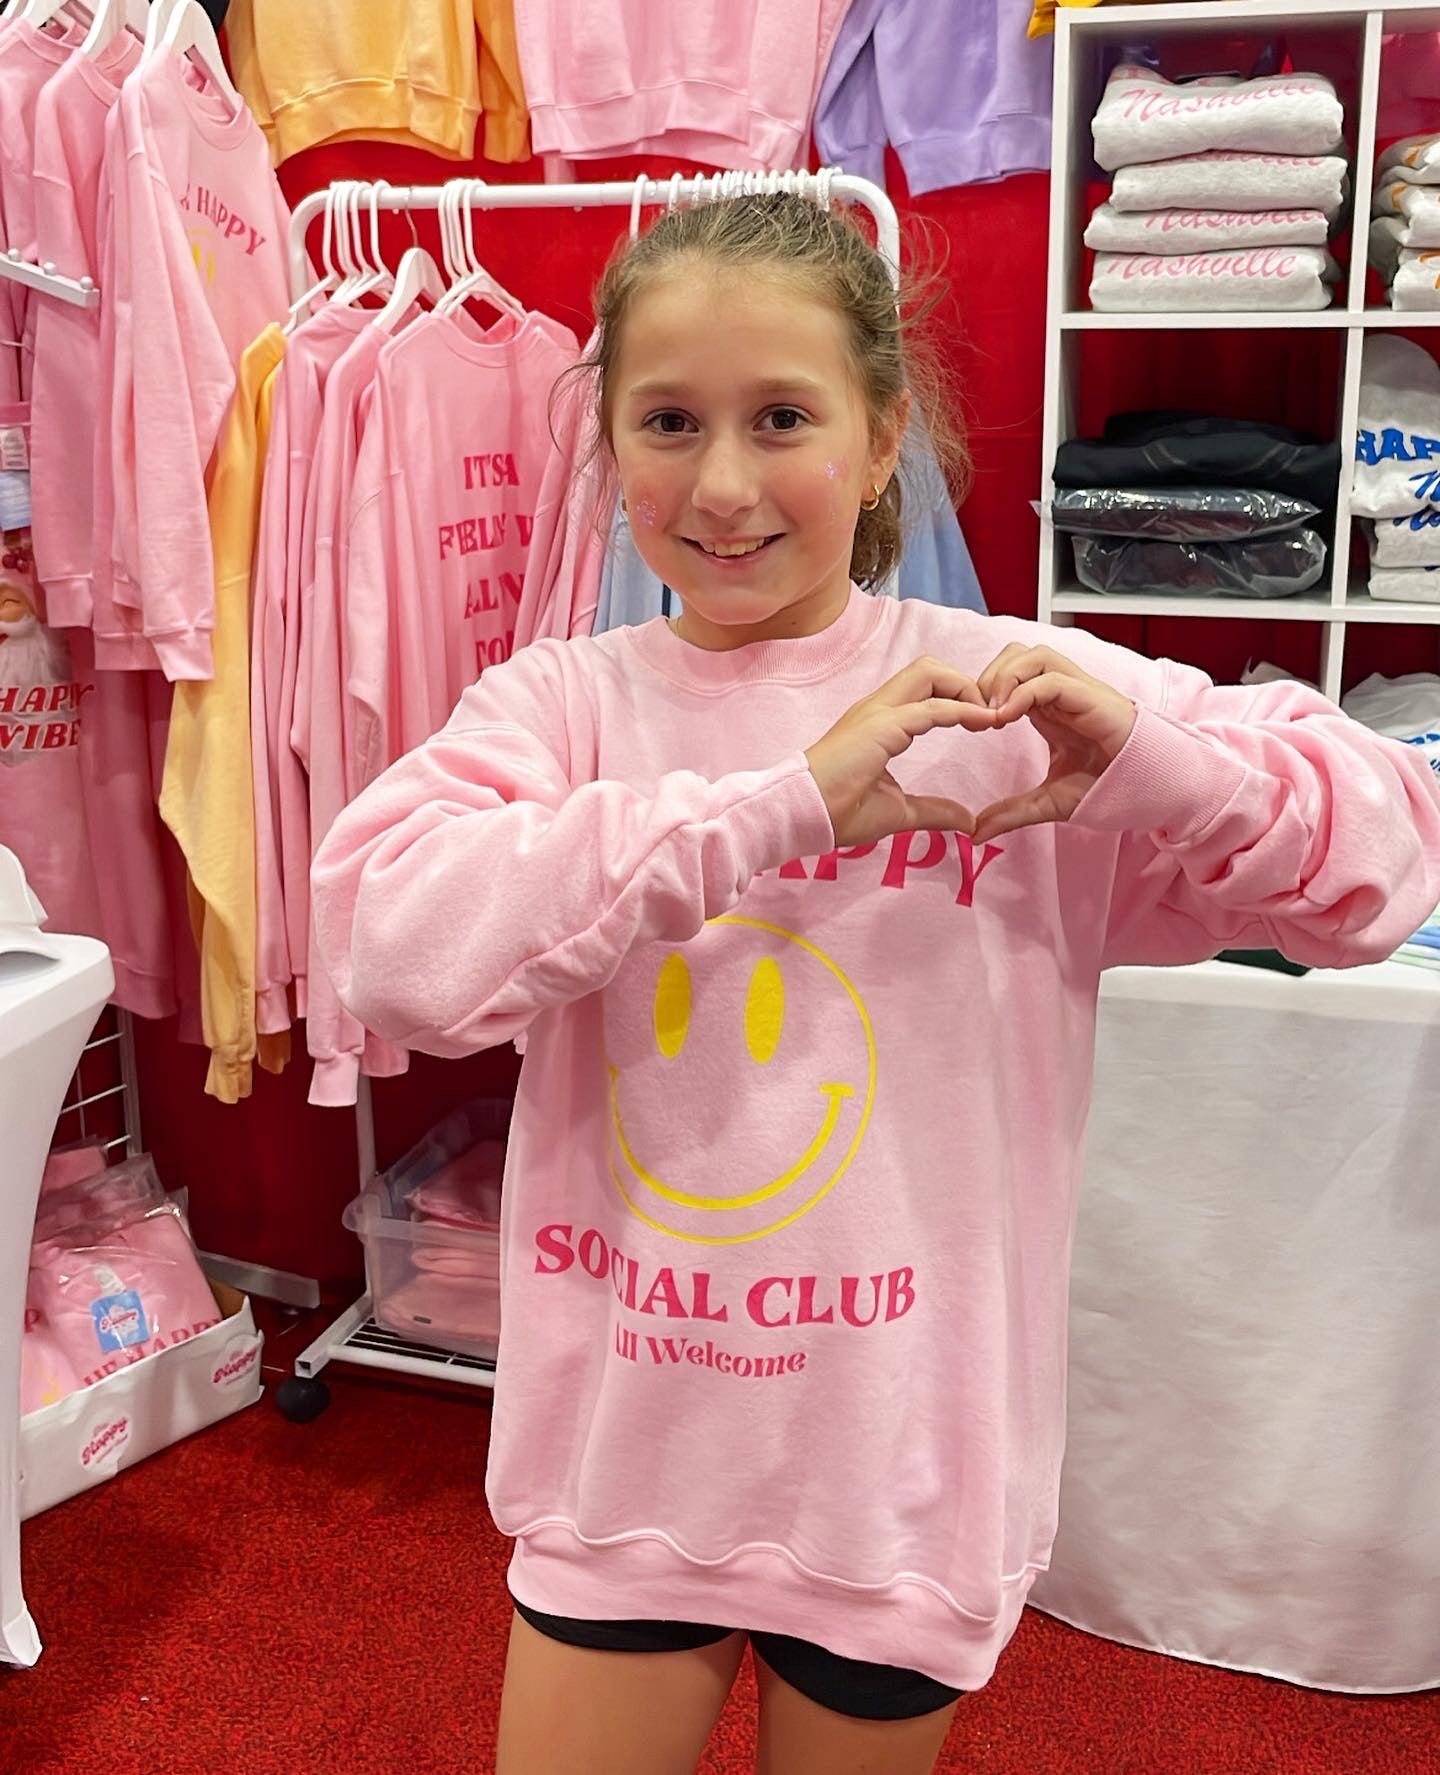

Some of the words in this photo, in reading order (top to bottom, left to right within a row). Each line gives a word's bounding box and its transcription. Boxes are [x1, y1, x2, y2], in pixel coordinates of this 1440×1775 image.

[534, 1223, 728, 1323] SOCIAL
[745, 1265, 916, 1329] CLUB
[643, 1334, 808, 1378] Welcome
